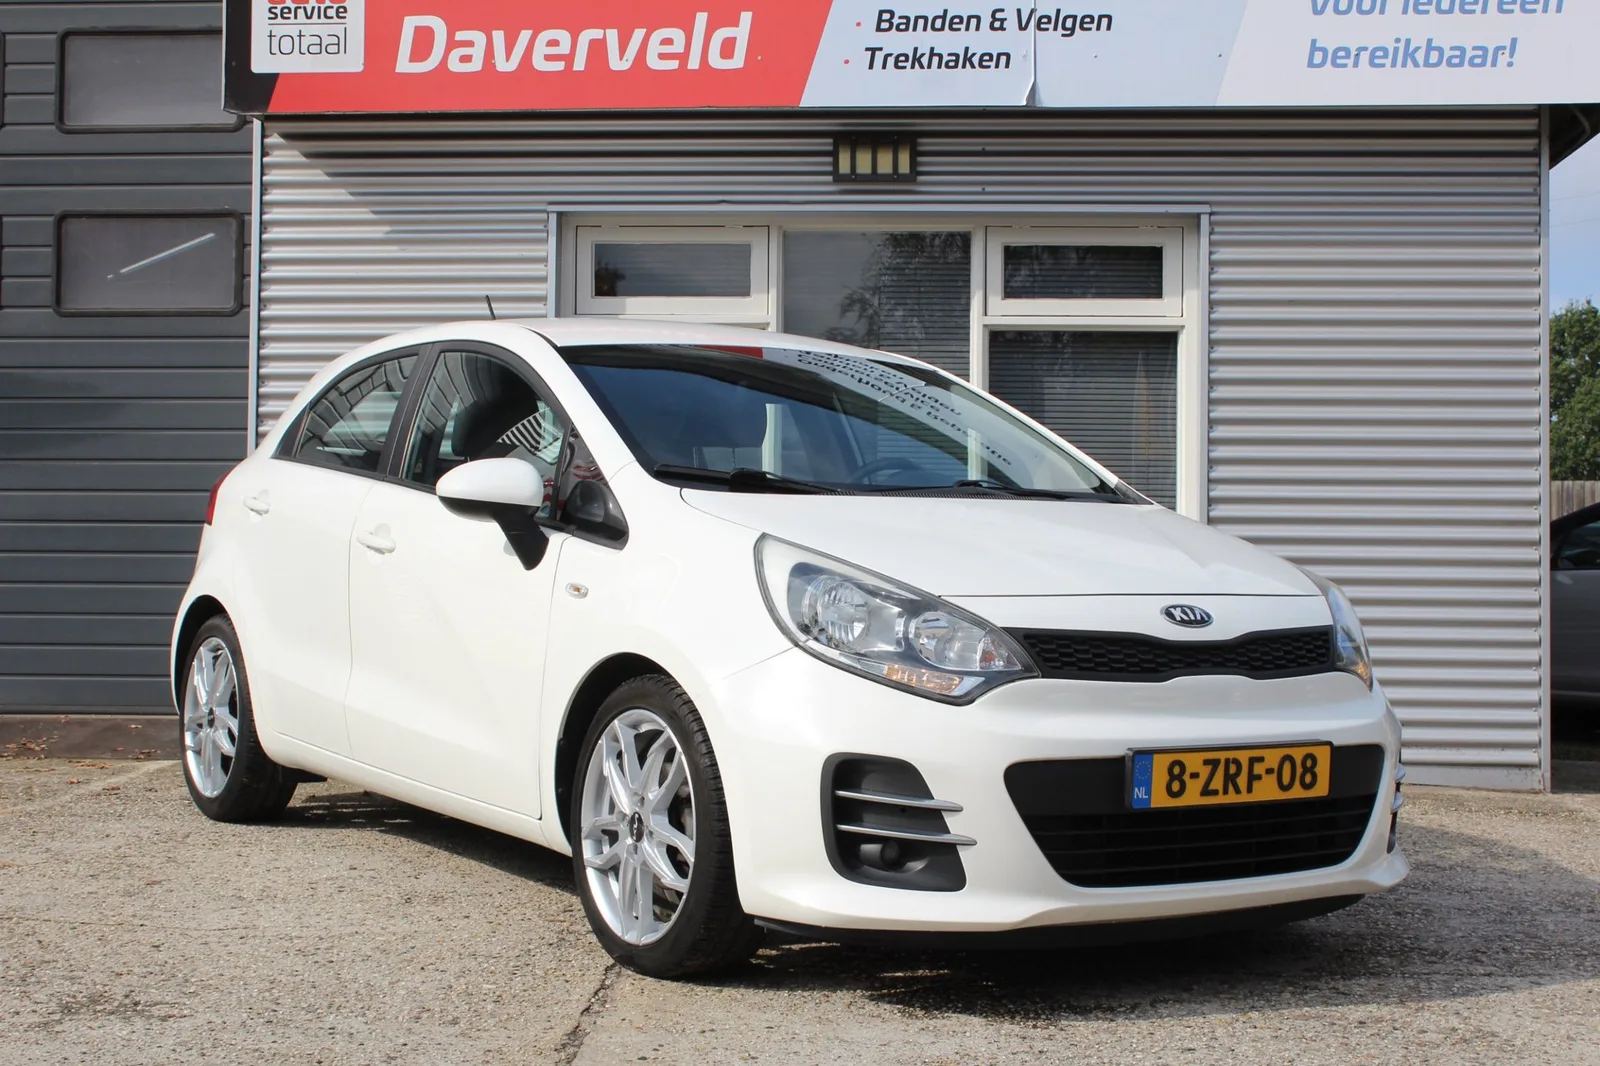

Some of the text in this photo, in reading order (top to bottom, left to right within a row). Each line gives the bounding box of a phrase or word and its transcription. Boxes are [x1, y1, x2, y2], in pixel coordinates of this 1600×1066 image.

[268, 5, 348, 20] service
[875, 8, 1113, 37] Banden & Velgen
[267, 26, 347, 55] totaal
[395, 11, 753, 73] Daverveld
[1306, 37, 1518, 68] bereikbaar!
[864, 46, 1011, 70] Trekhaken
[1165, 753, 1318, 799] 8-ZRF-08
[1134, 787, 1149, 799] NL
